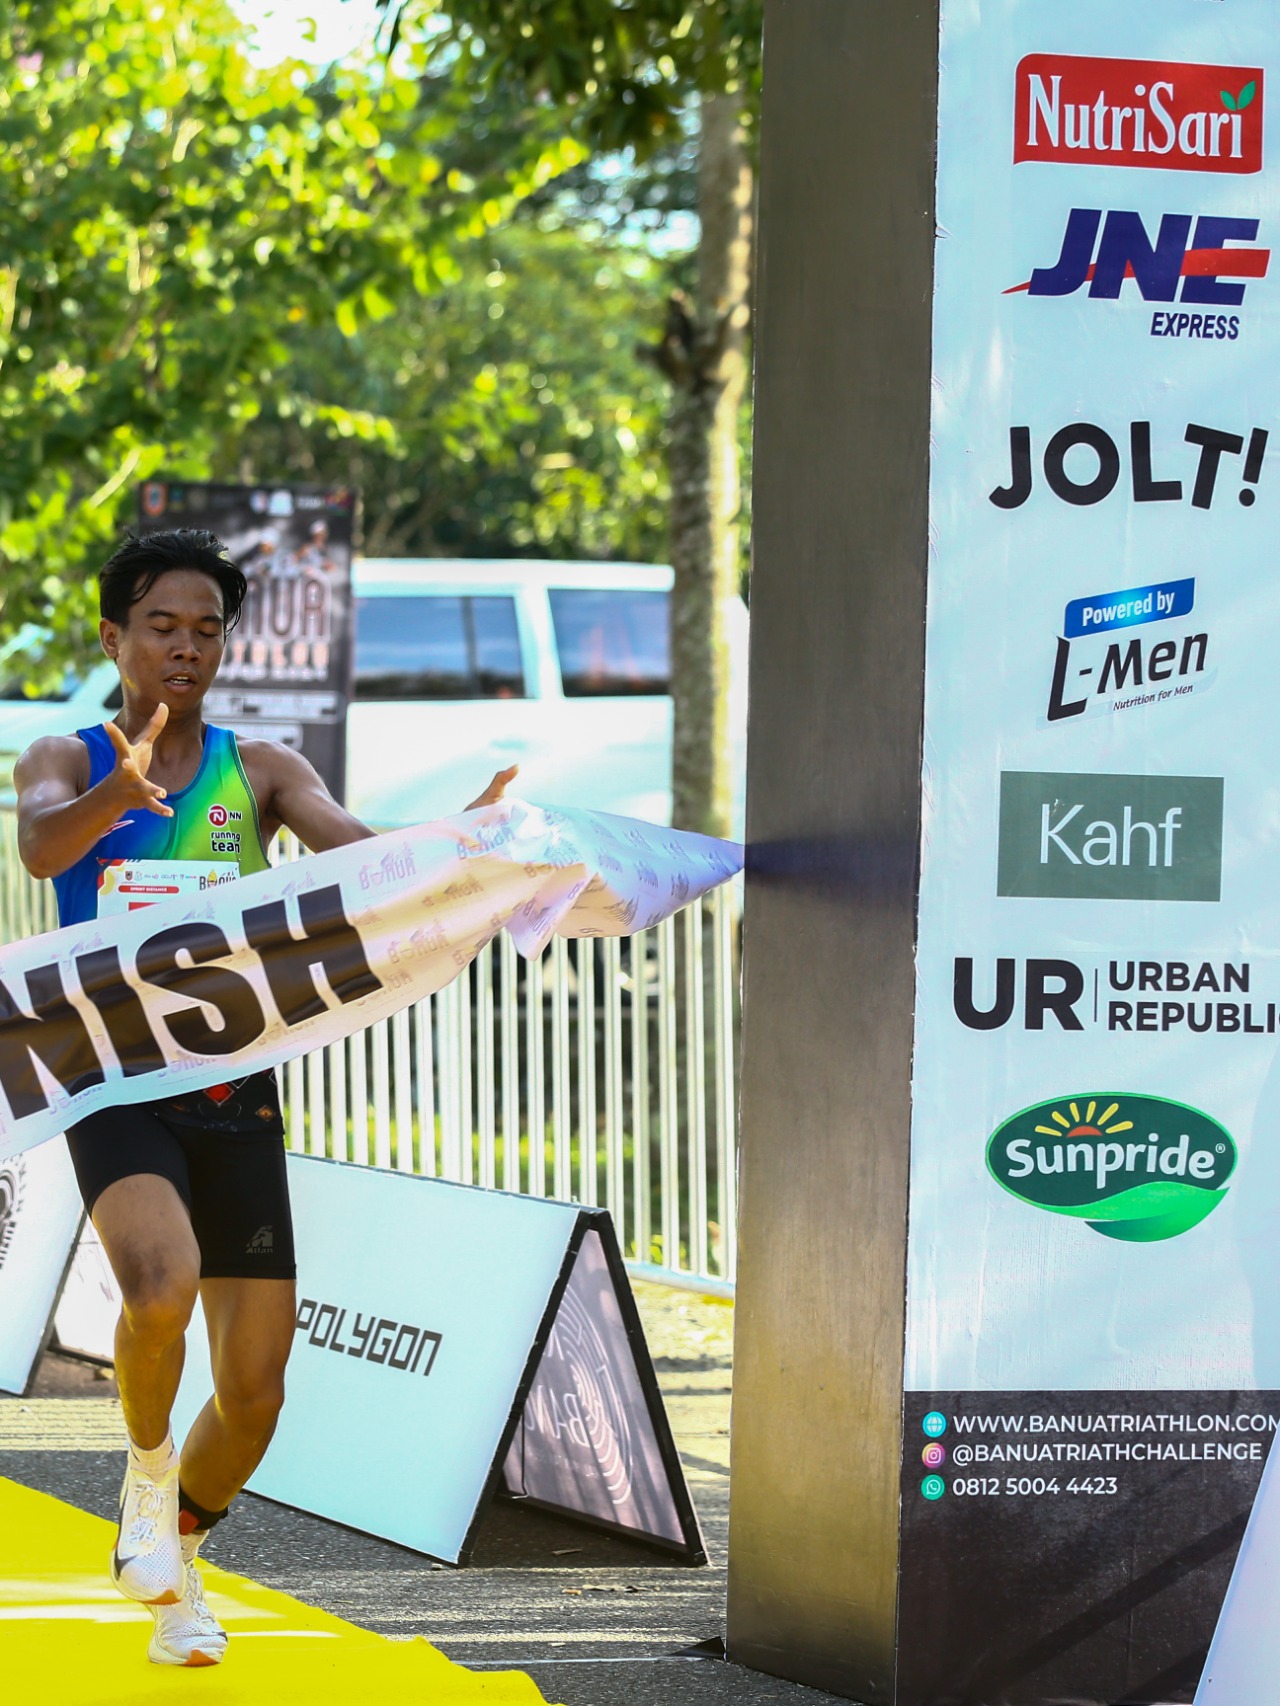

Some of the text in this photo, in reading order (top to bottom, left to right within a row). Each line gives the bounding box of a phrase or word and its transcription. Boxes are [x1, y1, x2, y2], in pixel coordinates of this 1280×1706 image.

[1027, 74, 1243, 159] NutriSari
[1028, 208, 1260, 306] JNE
[1150, 312, 1240, 340] EXPRESS
[989, 421, 1269, 509] JOLT!
[1082, 591, 1176, 627] Powered by
[1047, 633, 1209, 722] L-Men
[1113, 684, 1193, 711] Nutrition for Men
[230, 811, 242, 820] NN
[211, 832, 241, 842] runnng
[1039, 804, 1182, 867] Kahf
[953, 956, 1085, 1031] UR
[1108, 961, 1250, 993] URBAN
[1108, 1002, 1280, 1034] REPUBLI
[1006, 1134, 1216, 1189] Sunpride
[952, 1442, 1263, 1467] @BANUATRIATHCHALLENGE
[952, 1476, 1119, 1496] 0812 5004 4423
